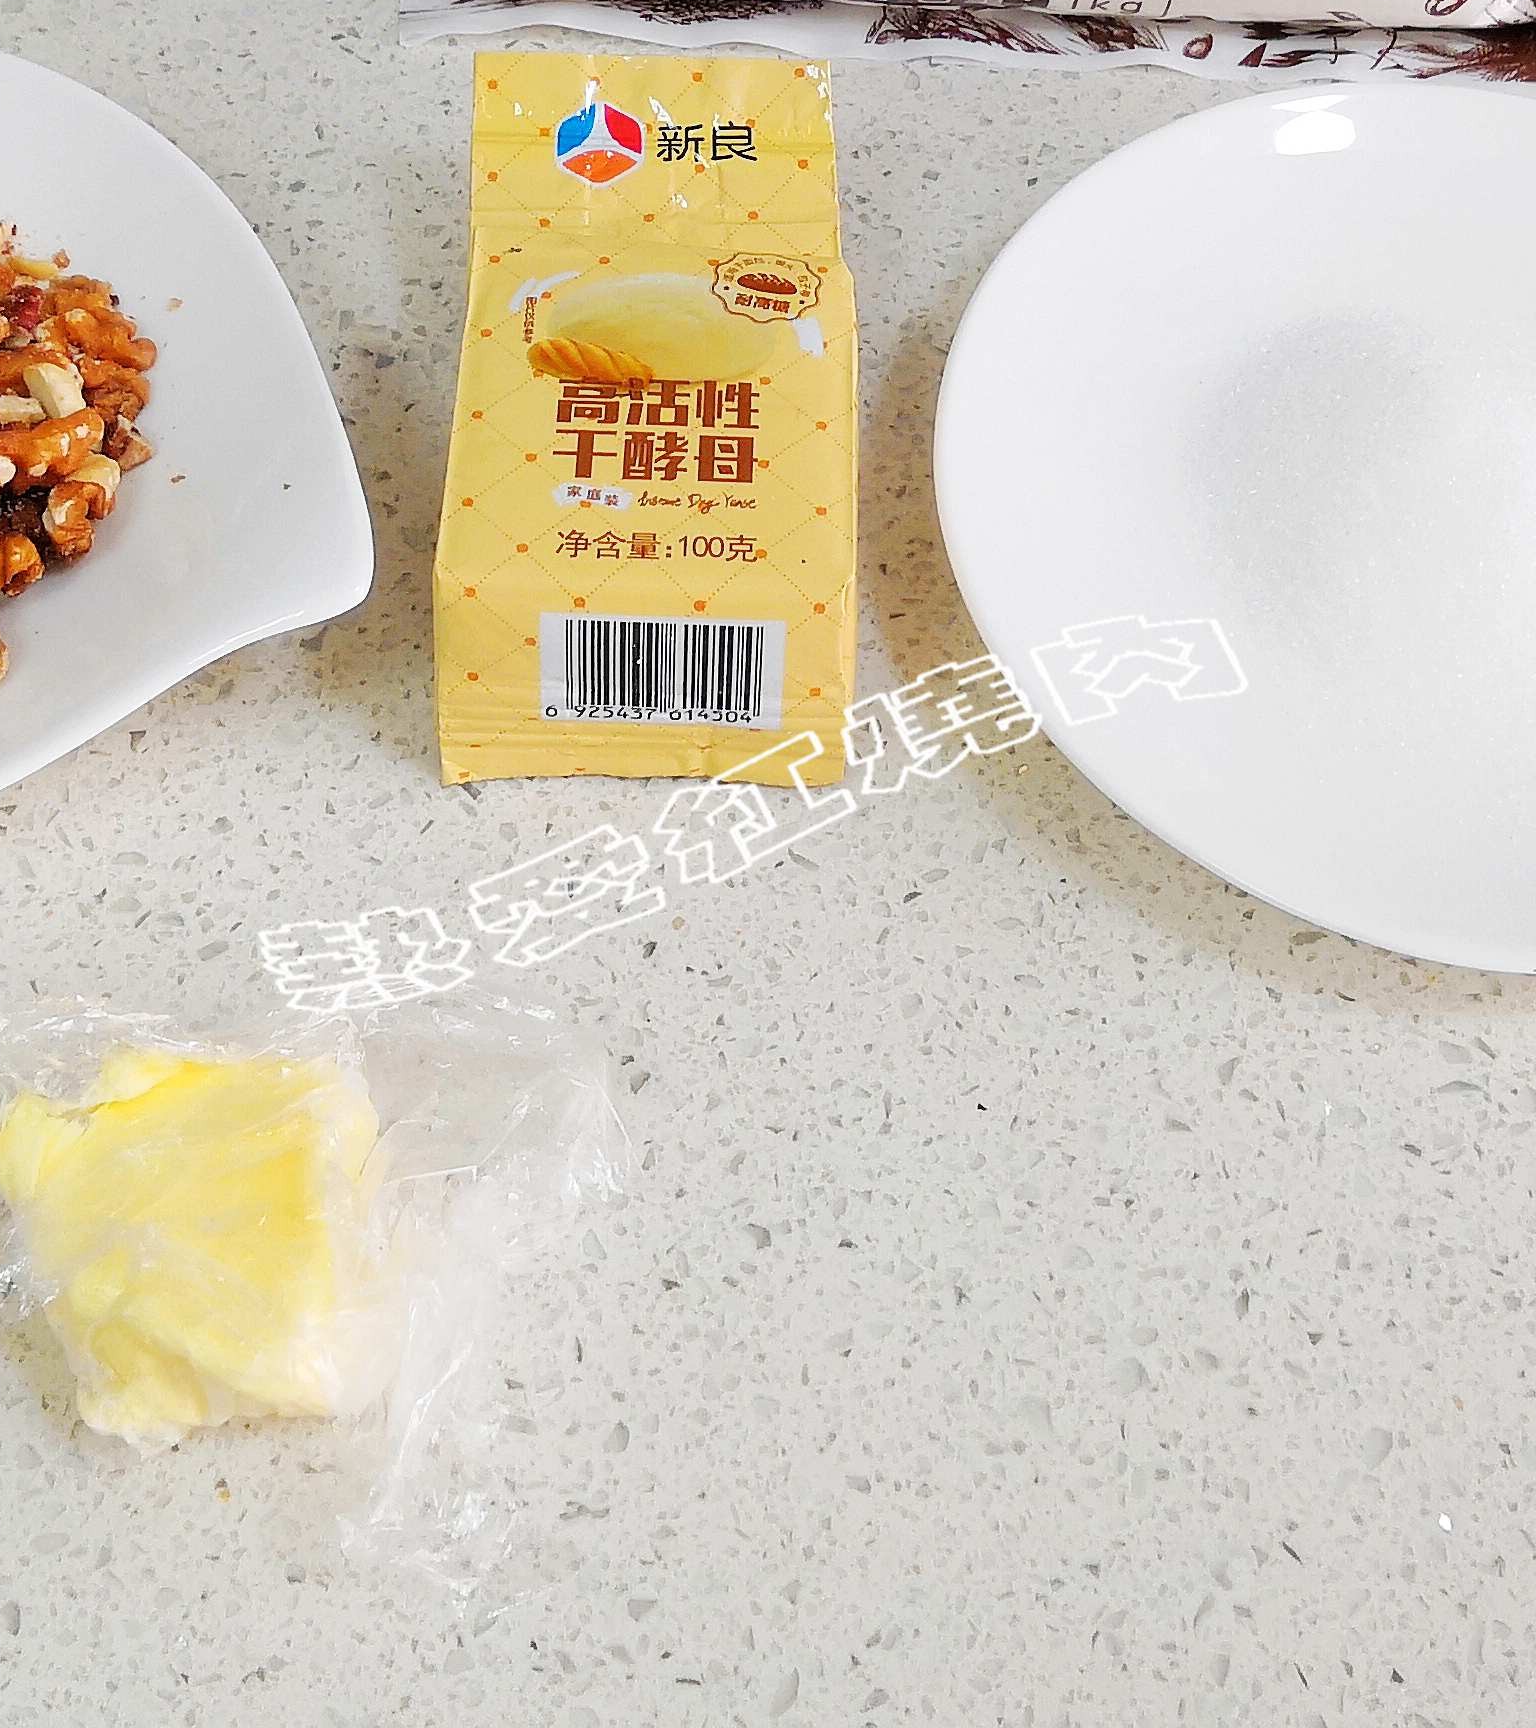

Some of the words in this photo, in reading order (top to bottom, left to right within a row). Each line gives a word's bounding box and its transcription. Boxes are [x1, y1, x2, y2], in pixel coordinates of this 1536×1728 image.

[656, 123, 757, 163] 新良
[556, 378, 760, 430] 高活性
[553, 428, 758, 484] 干酵母
[555, 529, 758, 563] 净含量:100克
[545, 704, 558, 717] 6
[574, 706, 657, 721] 925437
